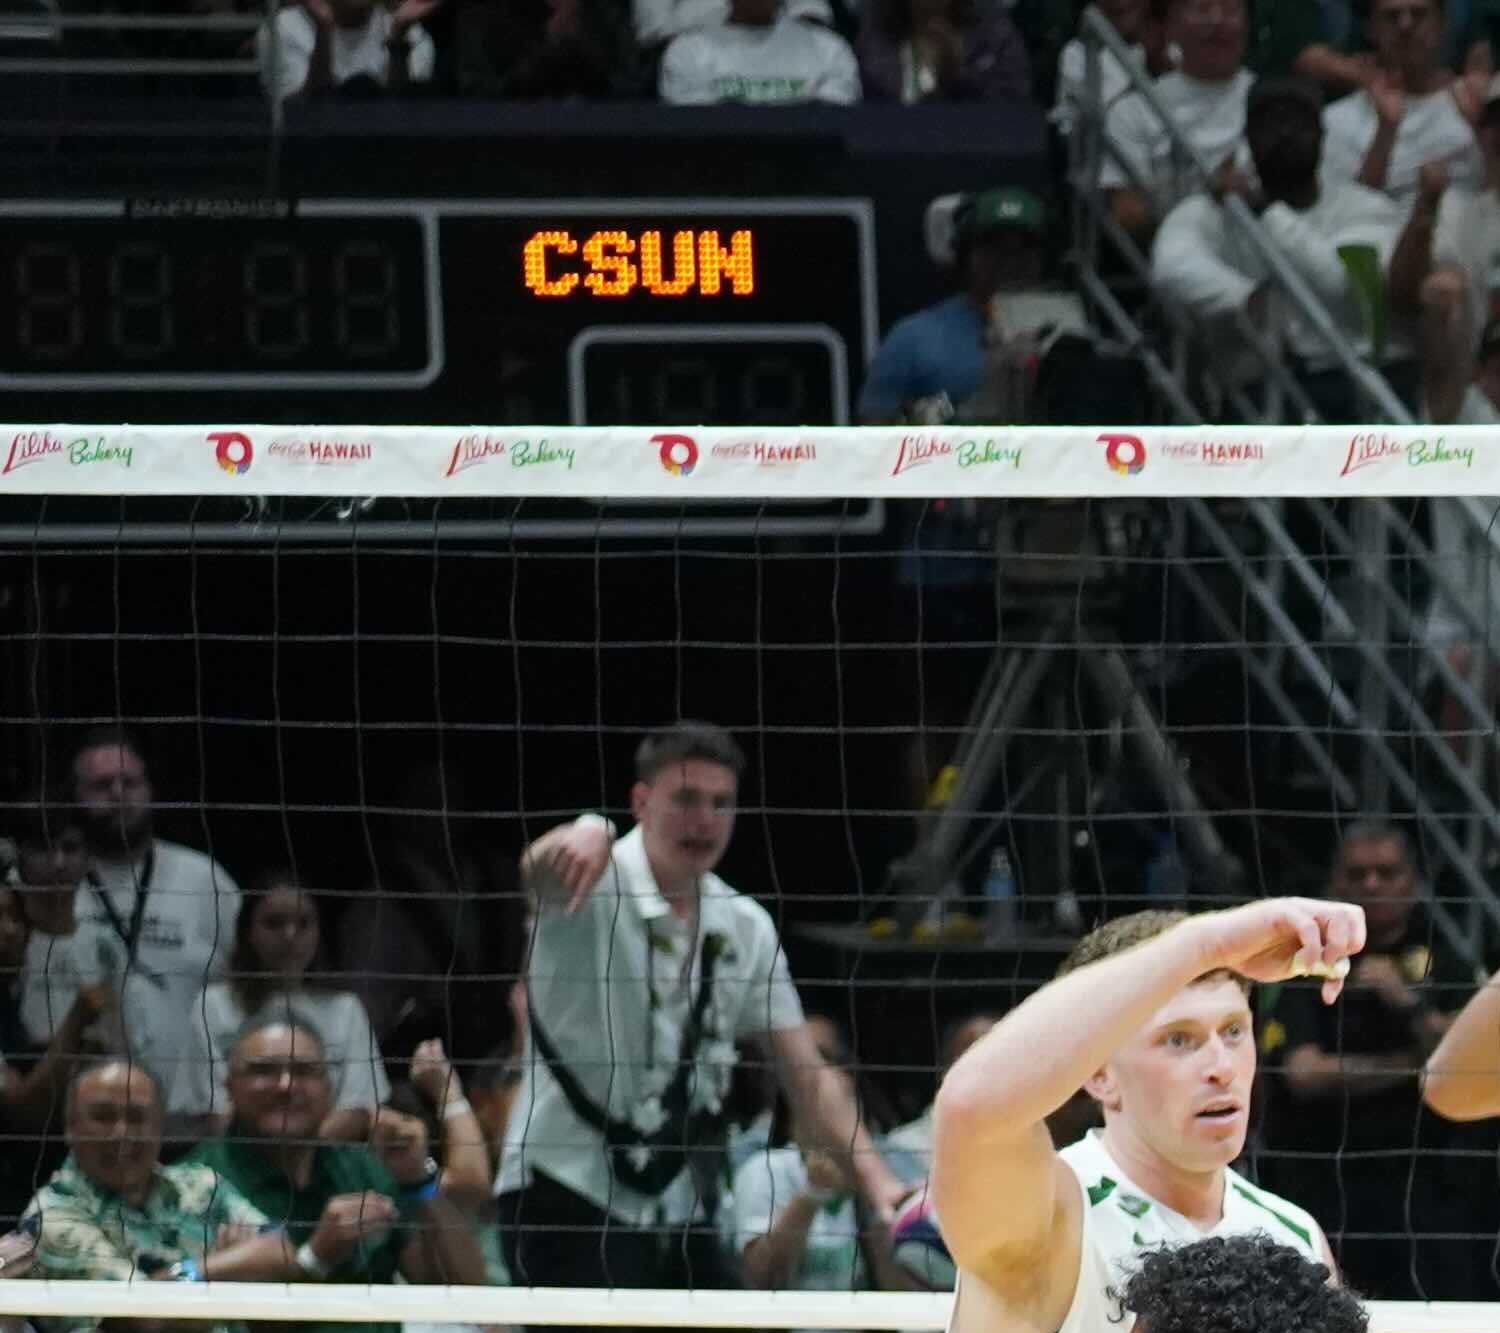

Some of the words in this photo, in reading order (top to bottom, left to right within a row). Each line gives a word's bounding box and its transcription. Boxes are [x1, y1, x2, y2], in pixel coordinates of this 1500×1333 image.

[522, 228, 756, 297] CSUN
[67, 437, 134, 468] Bakery
[309, 442, 372, 460] HAWAII
[510, 439, 576, 469] Bakery
[753, 443, 817, 461] HAWAII
[957, 439, 1023, 469] Bakery
[1200, 442, 1263, 460] HAWAII
[1406, 439, 1475, 468] Bakery
